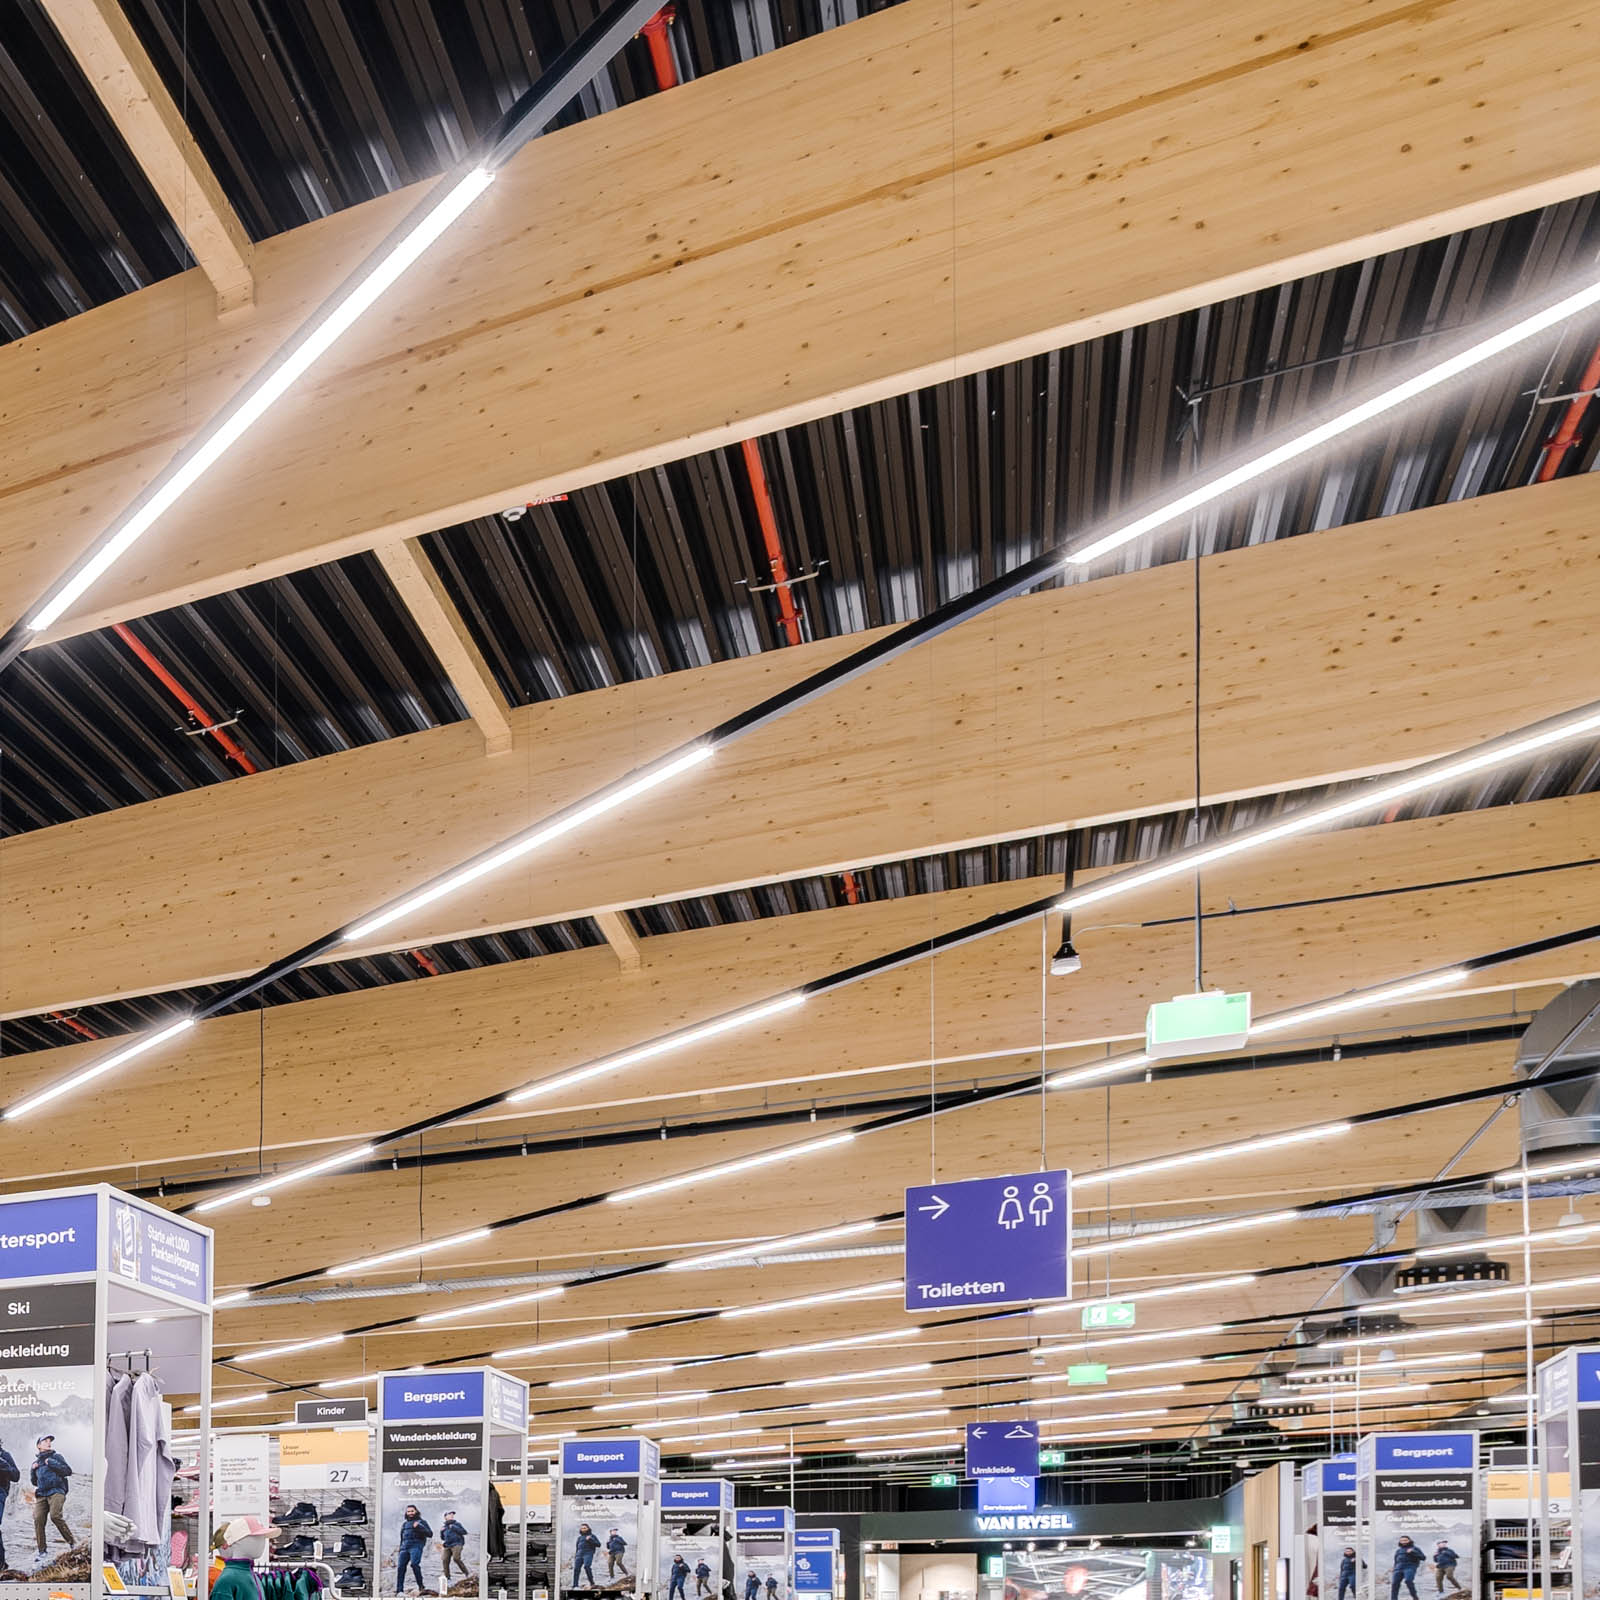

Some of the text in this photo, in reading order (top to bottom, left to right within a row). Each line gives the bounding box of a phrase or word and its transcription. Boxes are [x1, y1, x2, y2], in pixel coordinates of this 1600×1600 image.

[917, 1281, 1006, 1299] Toiletten
[7, 1301, 31, 1316] Ski
[403, 1390, 466, 1404] Bergsport
[316, 1406, 346, 1416] Kinder
[390, 1431, 477, 1443] Wanderbekleidung
[576, 1453, 625, 1463] Bergsport
[1392, 1447, 1454, 1459] Bergsport
[398, 1457, 468, 1467] Wanderschuhe
[971, 1466, 1016, 1474] Umkleide
[574, 1483, 628, 1491] Wanderschuhe
[1380, 1479, 1468, 1489] Wanderausrüstung
[671, 1491, 710, 1499] Bergsport
[1383, 1498, 1465, 1507] Wanderrucksäcke
[977, 1514, 1073, 1530] VAN RYSEL
